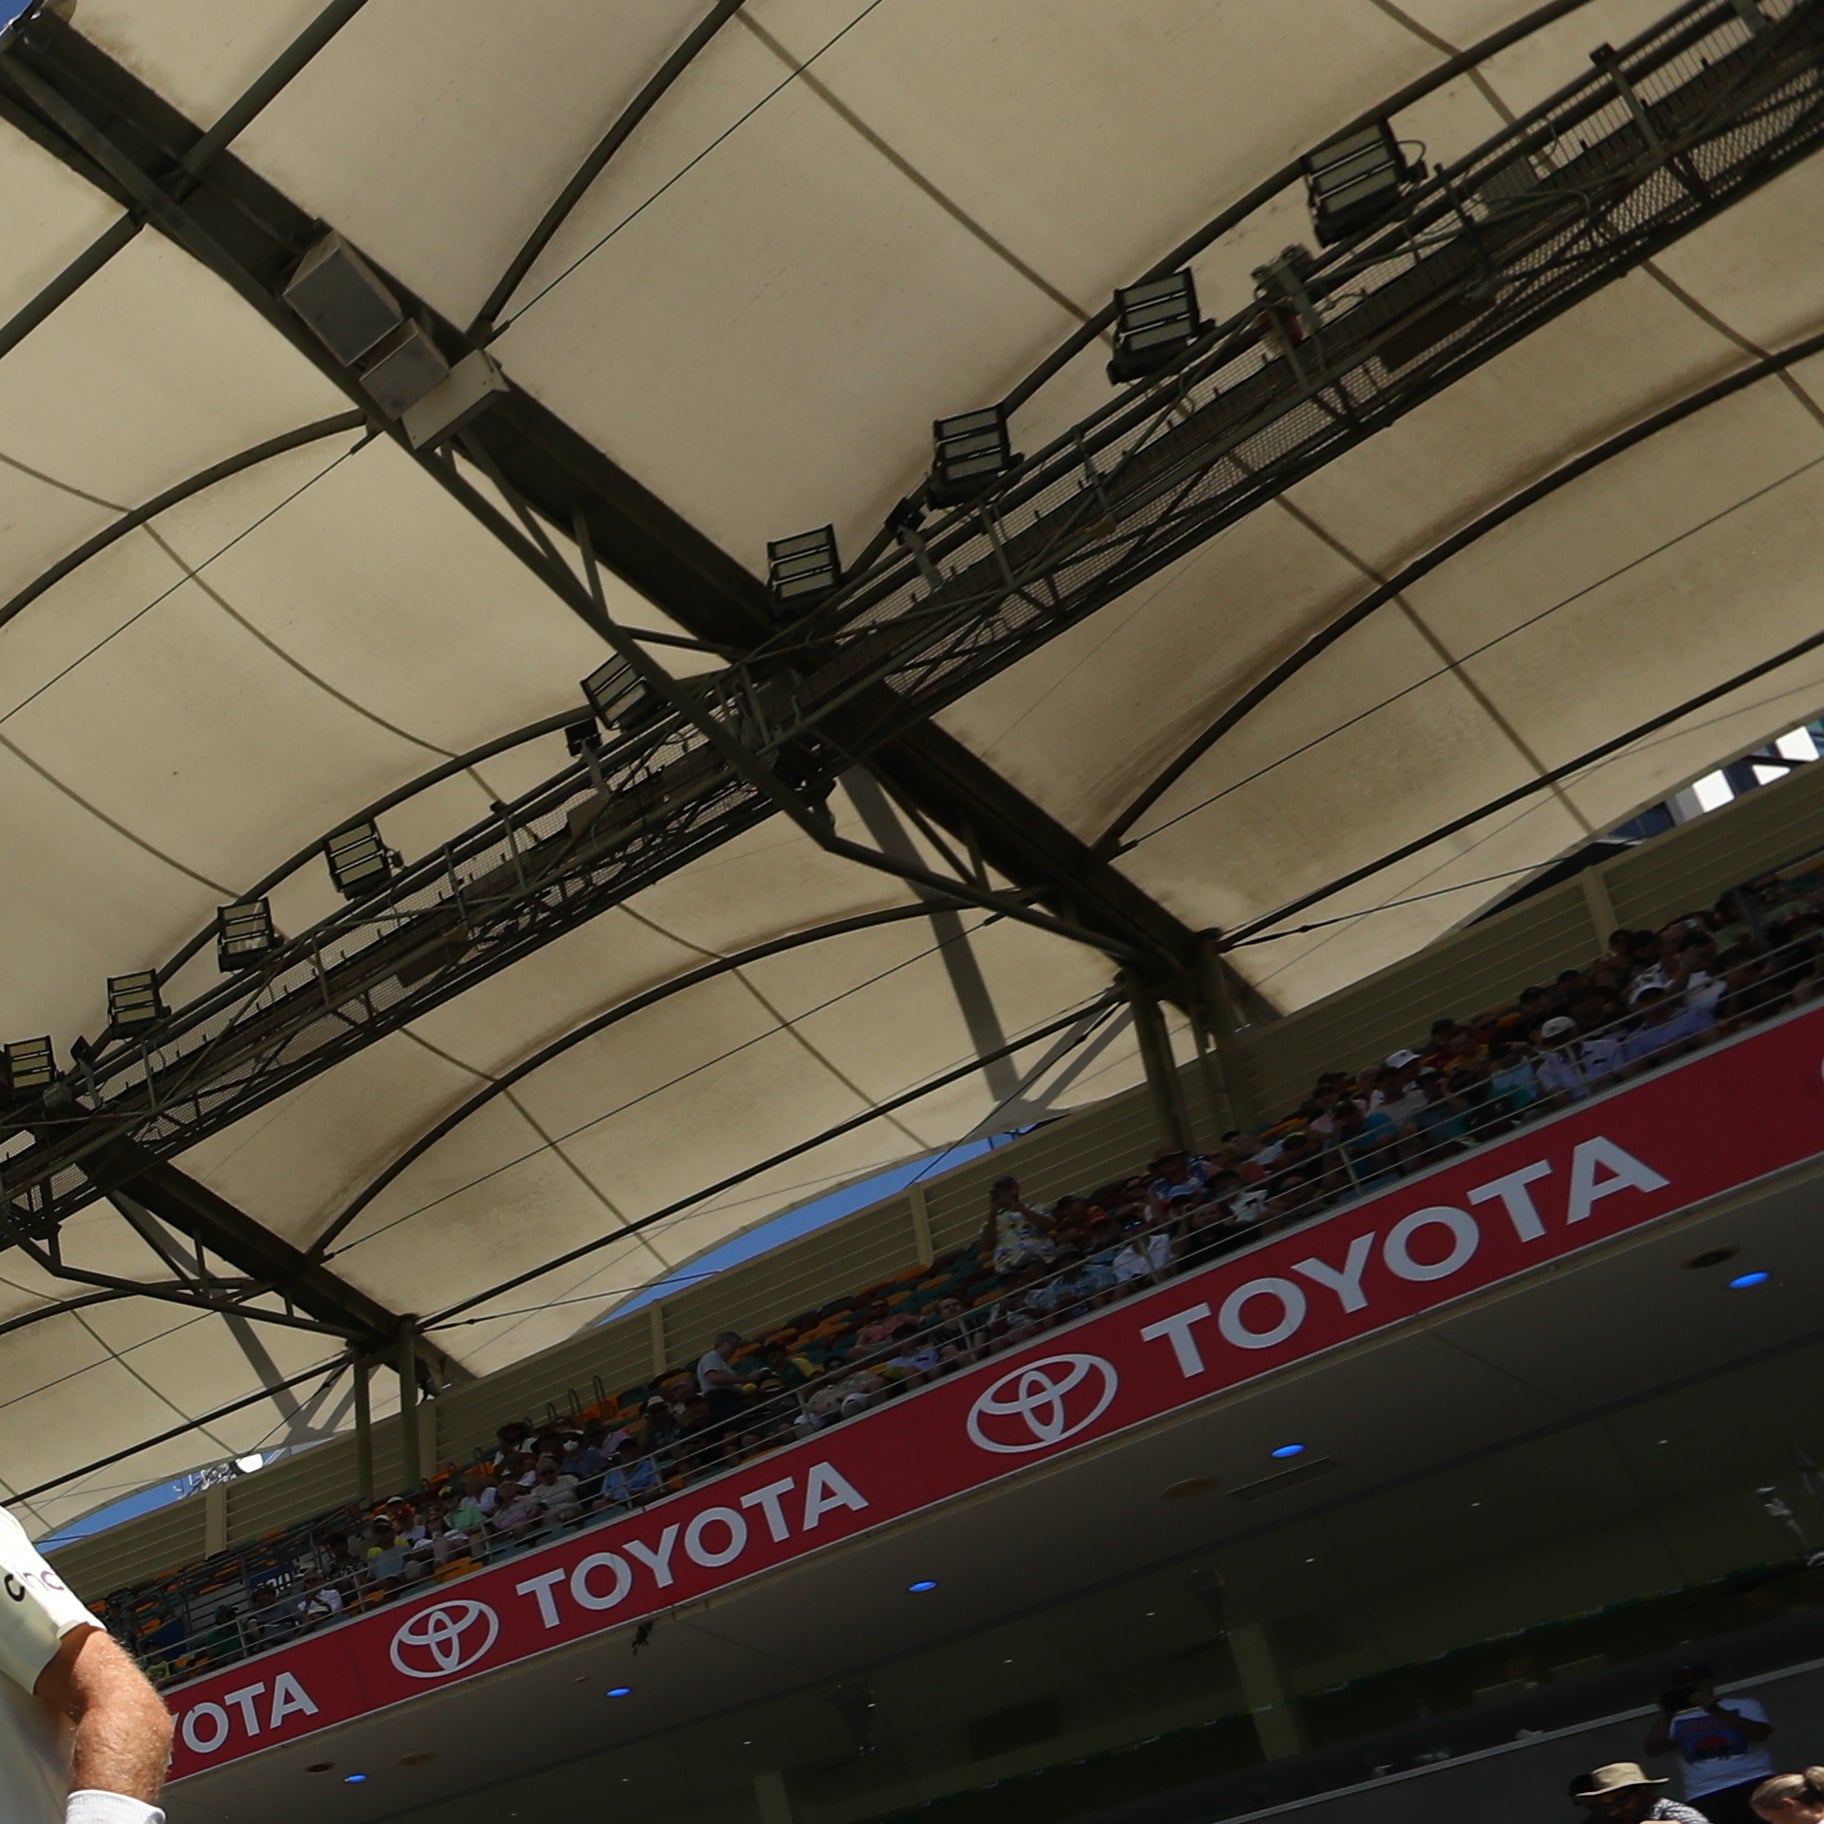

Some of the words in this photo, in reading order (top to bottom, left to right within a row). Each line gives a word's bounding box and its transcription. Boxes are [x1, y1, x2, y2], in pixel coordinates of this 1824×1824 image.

[1141, 1135, 1670, 1378] TOYOTA
[515, 1461, 870, 1630] TOYOTA
[169, 1671, 319, 1765] OTA
